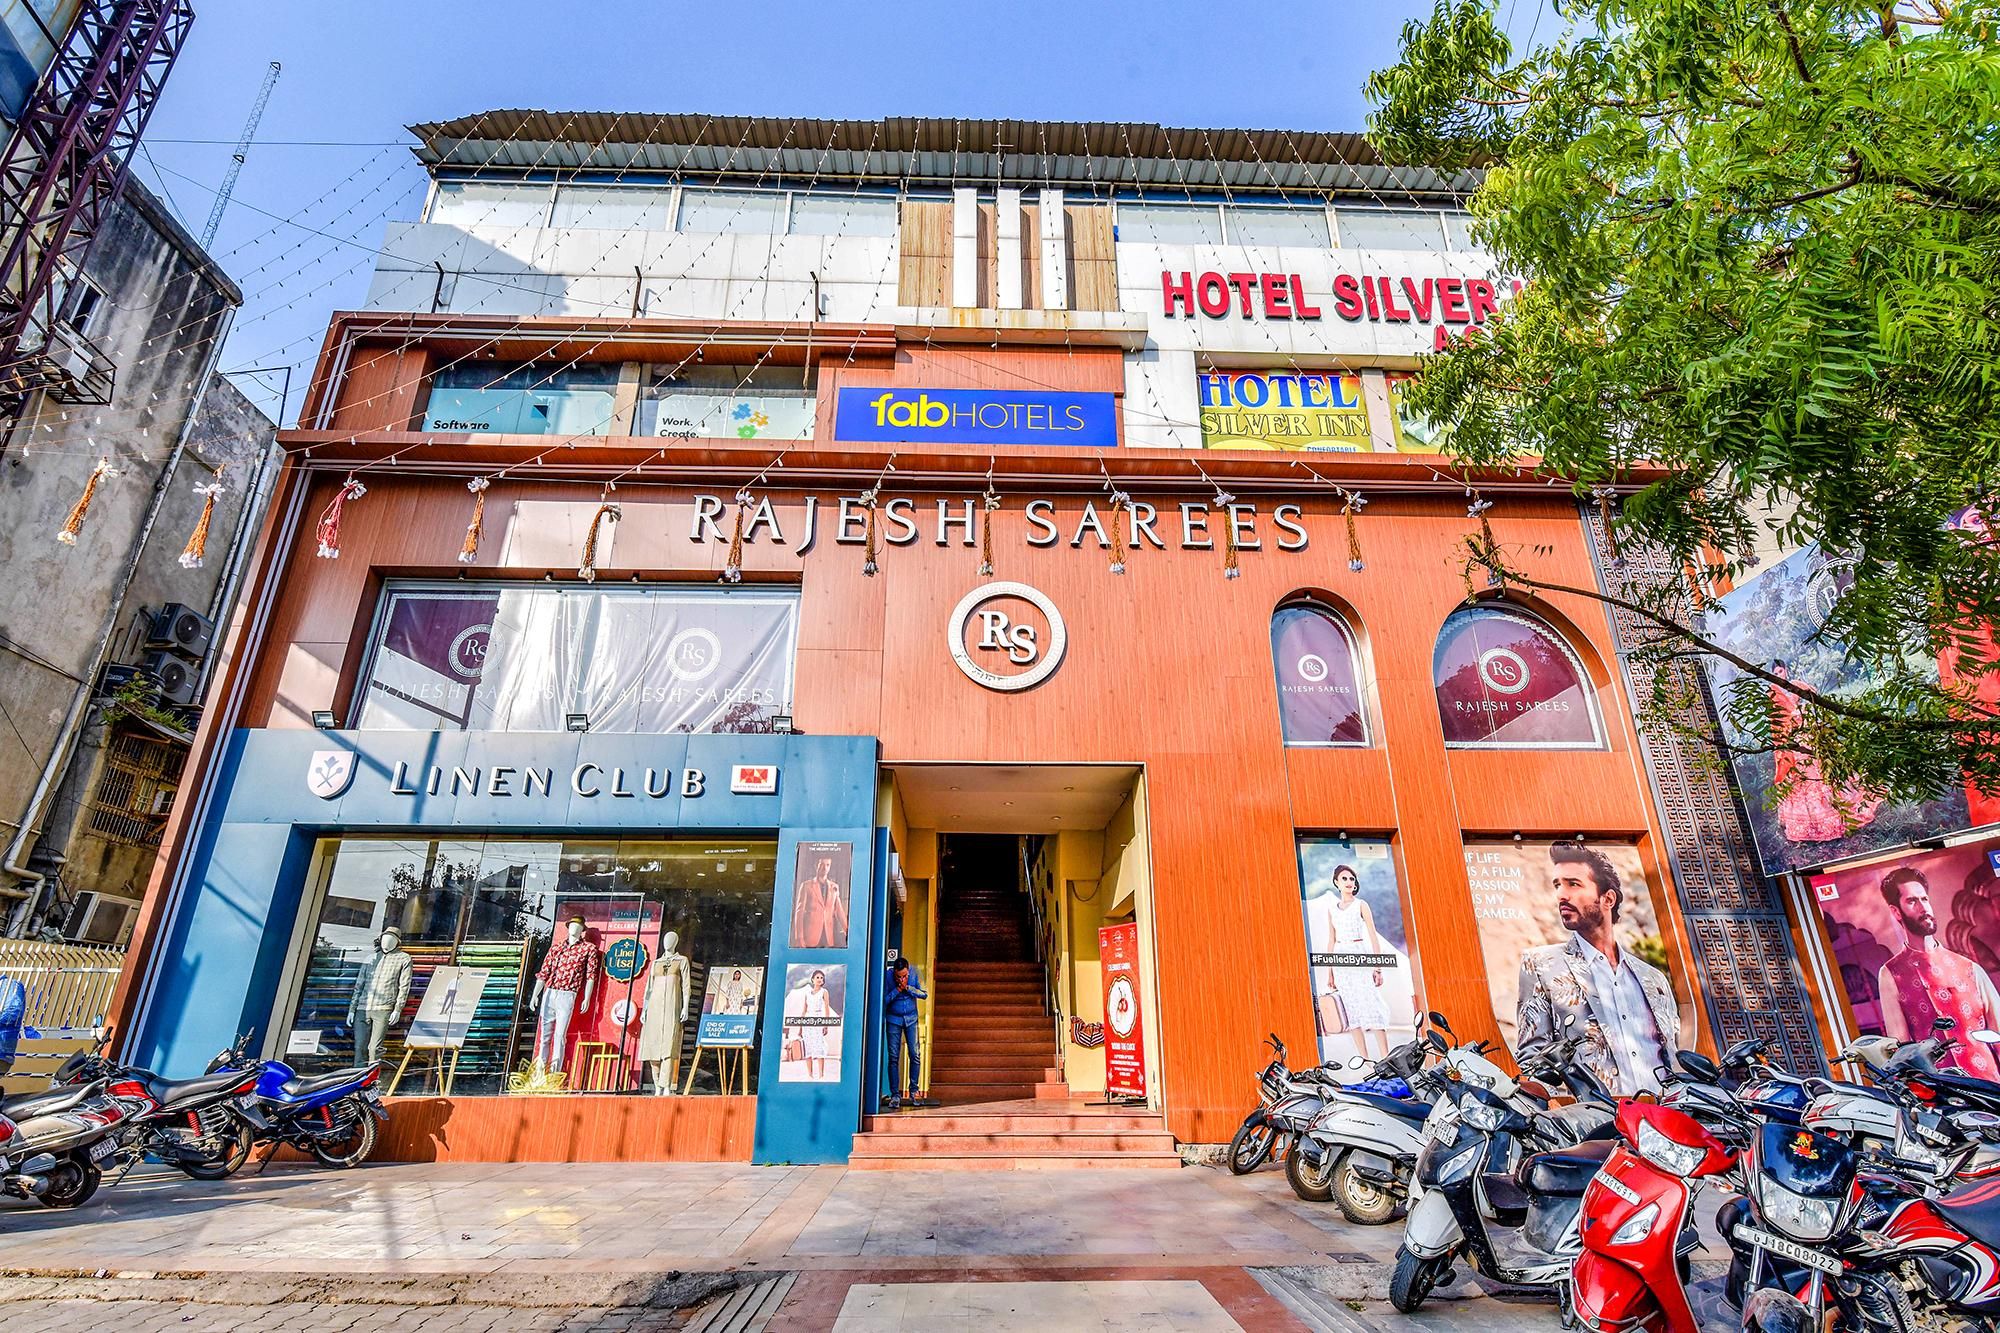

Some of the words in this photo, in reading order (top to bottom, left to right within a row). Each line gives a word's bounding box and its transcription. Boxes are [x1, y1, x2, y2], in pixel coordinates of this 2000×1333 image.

[1162, 271, 1322, 320] HOTEL
[1333, 274, 1499, 325] SILVER
[1199, 373, 1359, 409] HOTEL
[433, 420, 490, 431] Software
[662, 417, 693, 427] Work.
[1200, 413, 1311, 437] SILVER
[1318, 414, 1371, 437] INN
[689, 494, 977, 555] RAJESH
[1025, 500, 1309, 549] SAREES
[978, 610, 1037, 663] RS
[682, 642, 705, 667] RS
[1492, 661, 1517, 682] RS
[1282, 685, 1314, 693] RAJESH
[1318, 685, 1350, 694] SAREES
[1456, 700, 1509, 712] RAJESH
[1516, 701, 1571, 712] SAREES
[390, 761, 553, 798] LINEN
[571, 762, 707, 798] CLUB
[1476, 852, 1501, 864] LIFE
[1481, 867, 1489, 877] A
[1492, 866, 1525, 880] FILM,
[1470, 880, 1520, 891] PASSION
[1485, 893, 1504, 905] MY
[1475, 907, 1527, 919] CAMERA
[1311, 954, 1396, 966] #FuelledByPassion
